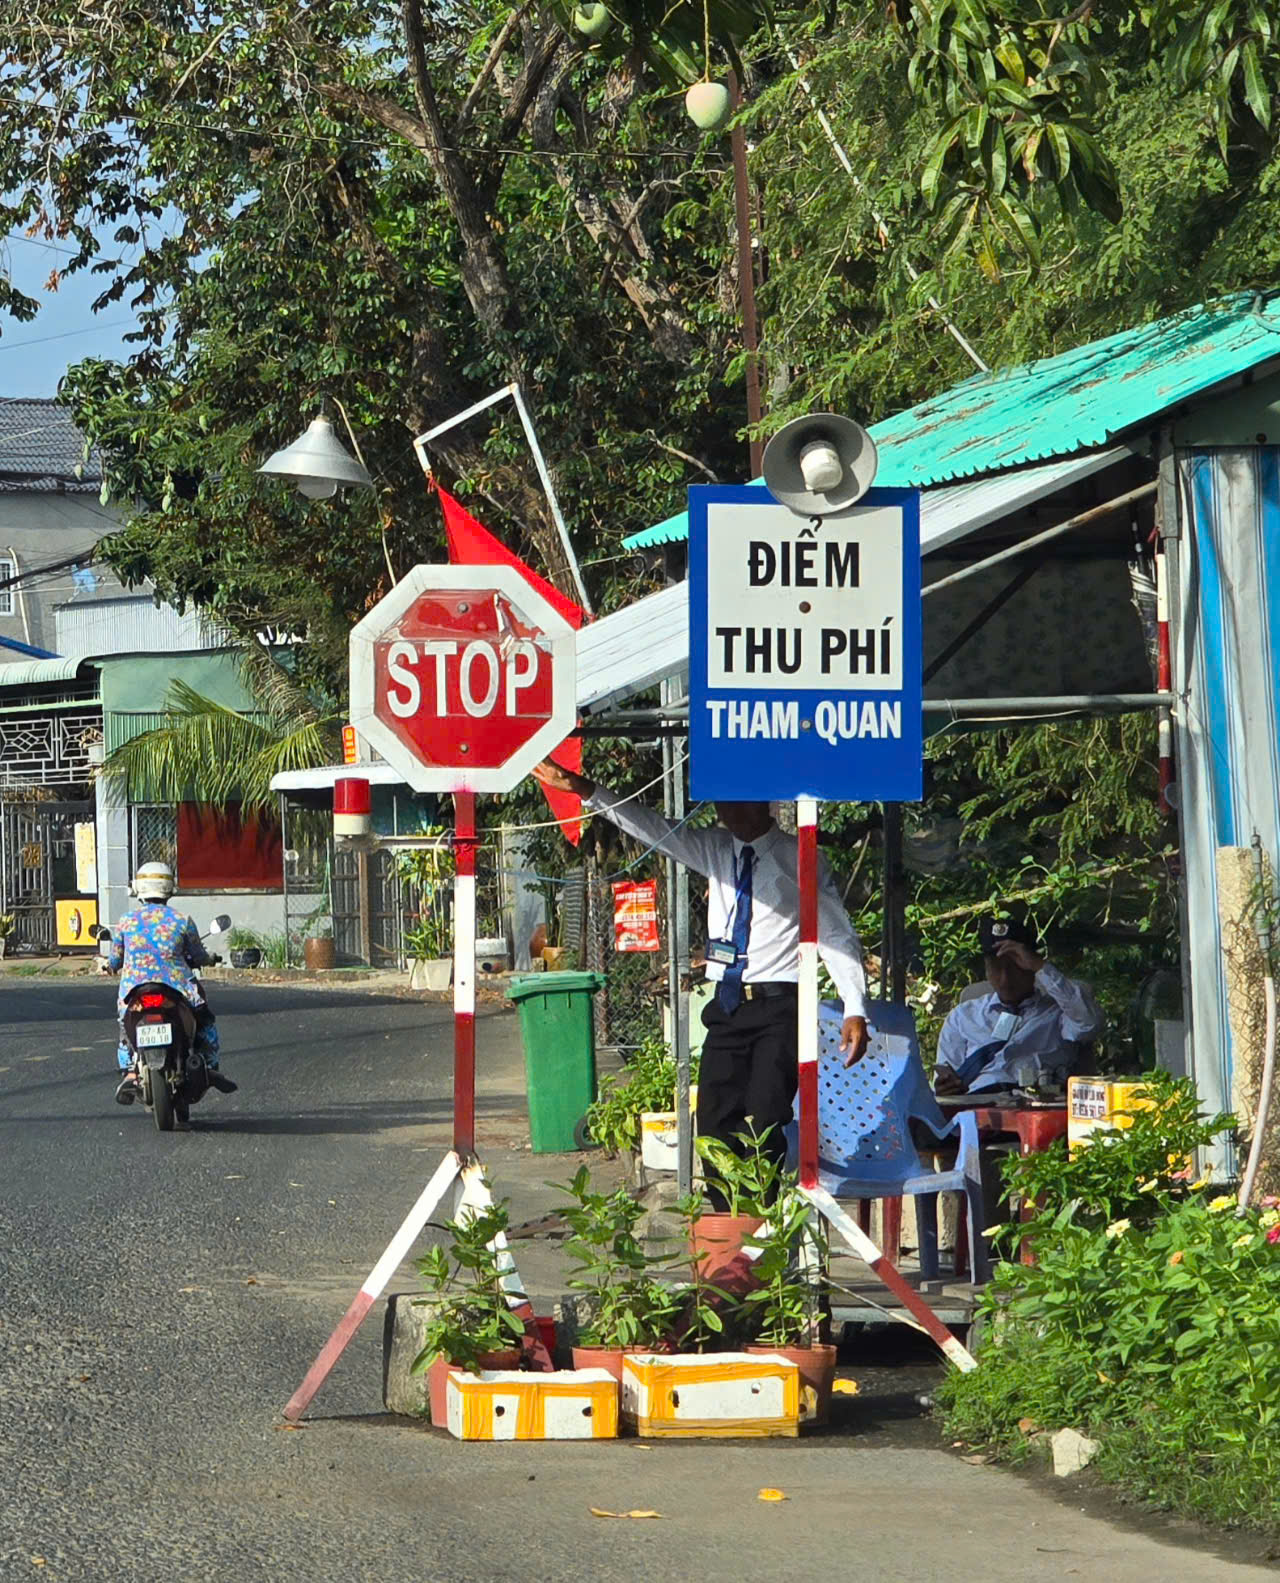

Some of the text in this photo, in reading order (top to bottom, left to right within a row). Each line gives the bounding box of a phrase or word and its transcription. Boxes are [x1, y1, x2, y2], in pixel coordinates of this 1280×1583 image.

[748, 515, 859, 587] ĐIỂM
[716, 616, 894, 675] THU PHÍ
[387, 640, 539, 718] STOP
[706, 700, 901, 746] THAM QUAN
